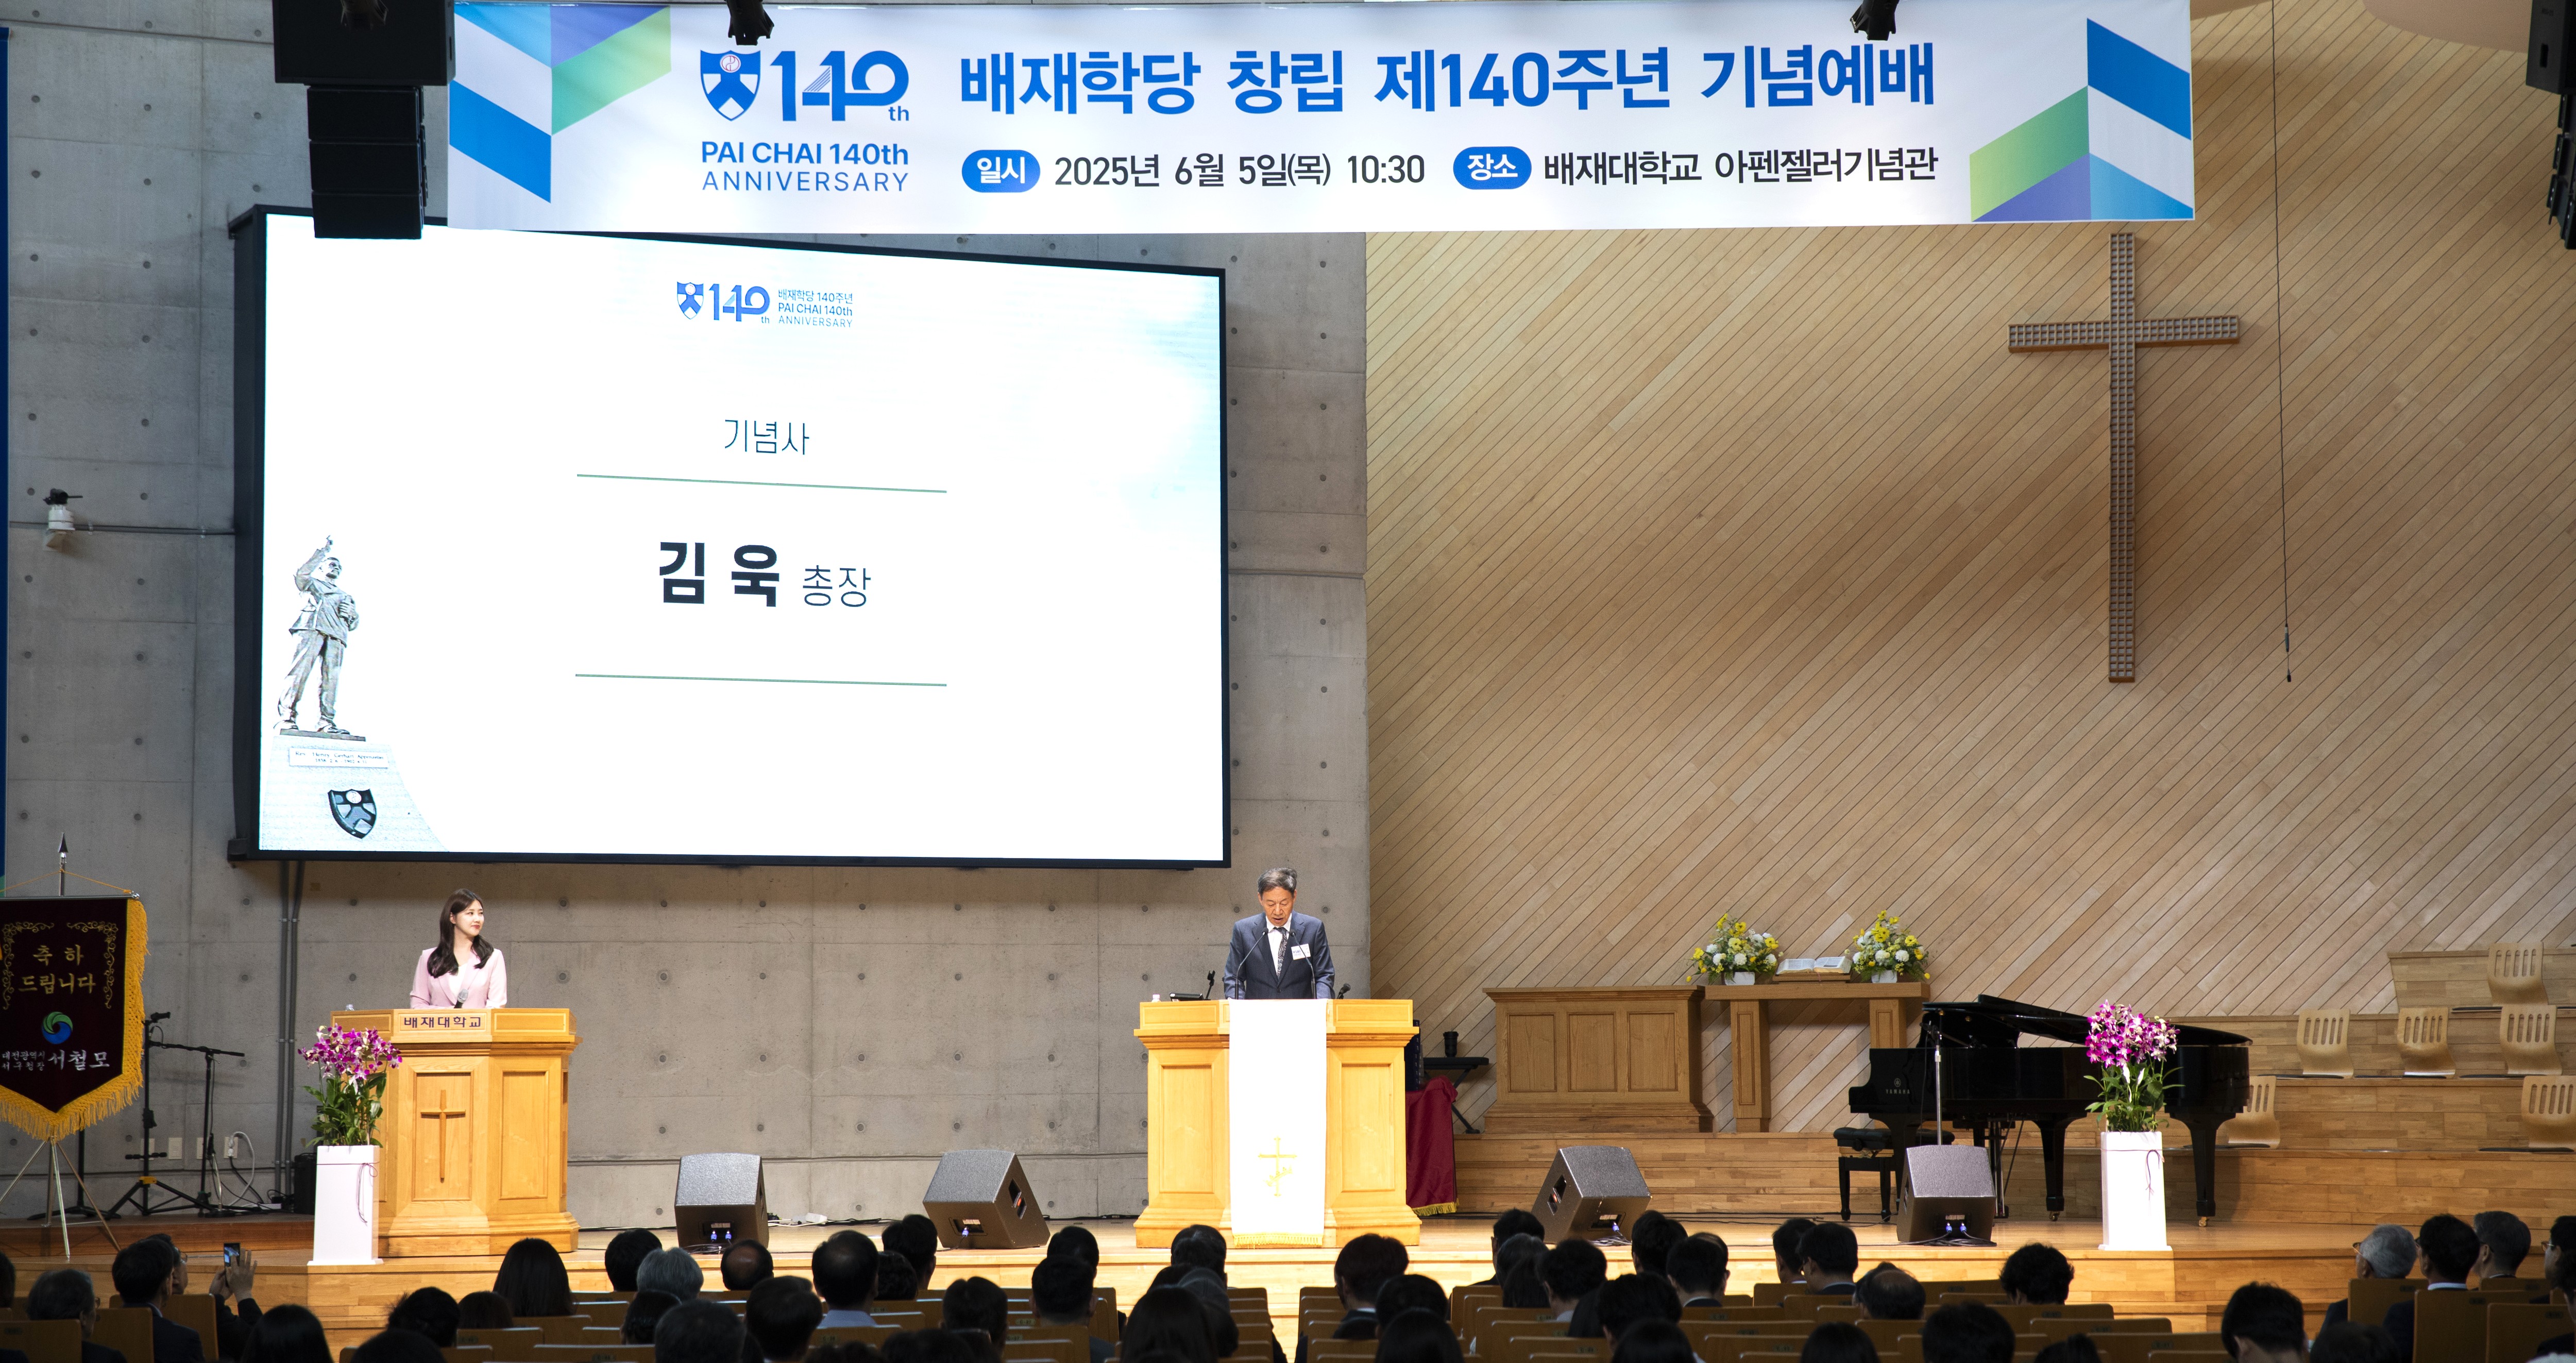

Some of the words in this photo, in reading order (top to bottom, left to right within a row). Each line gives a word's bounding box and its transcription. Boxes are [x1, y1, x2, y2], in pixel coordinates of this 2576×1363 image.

[961, 52, 1201, 114] 배재학당
[1227, 51, 1343, 113] 창립
[1375, 47, 1670, 111] 제140주년
[1701, 42, 1934, 107] 기념예배
[703, 142, 744, 163] PAI
[753, 143, 821, 164] CHAI
[830, 143, 909, 165] 140th
[977, 157, 1025, 184] 일시
[1056, 154, 1160, 187] 2025년
[1175, 154, 1224, 187] 6월
[1240, 154, 1331, 186] 5일(목)
[1348, 155, 1425, 183] 10:30
[1467, 154, 1518, 180] 장소
[1545, 152, 1701, 186] 배재대학교
[1716, 147, 1939, 183] 아펜젤러기념관
[702, 172, 909, 192] ANNIVERSARY
[778, 289, 815, 301] 배재학당
[817, 293, 853, 304] 140주년
[778, 302, 794, 313] PAI
[797, 304, 821, 314] CHAI
[824, 306, 853, 316] 140th
[778, 315, 853, 328] ANNIVERSARY
[725, 419, 810, 456] 기념사
[803, 565, 871, 607] 총장
[18, 973, 96, 995] 드립니다
[403, 1016, 482, 1029] 배재대학교
[2, 1051, 45, 1061] 대전광역시
[2, 1062, 44, 1071] 서구청장
[47, 1049, 110, 1071] 서철모
